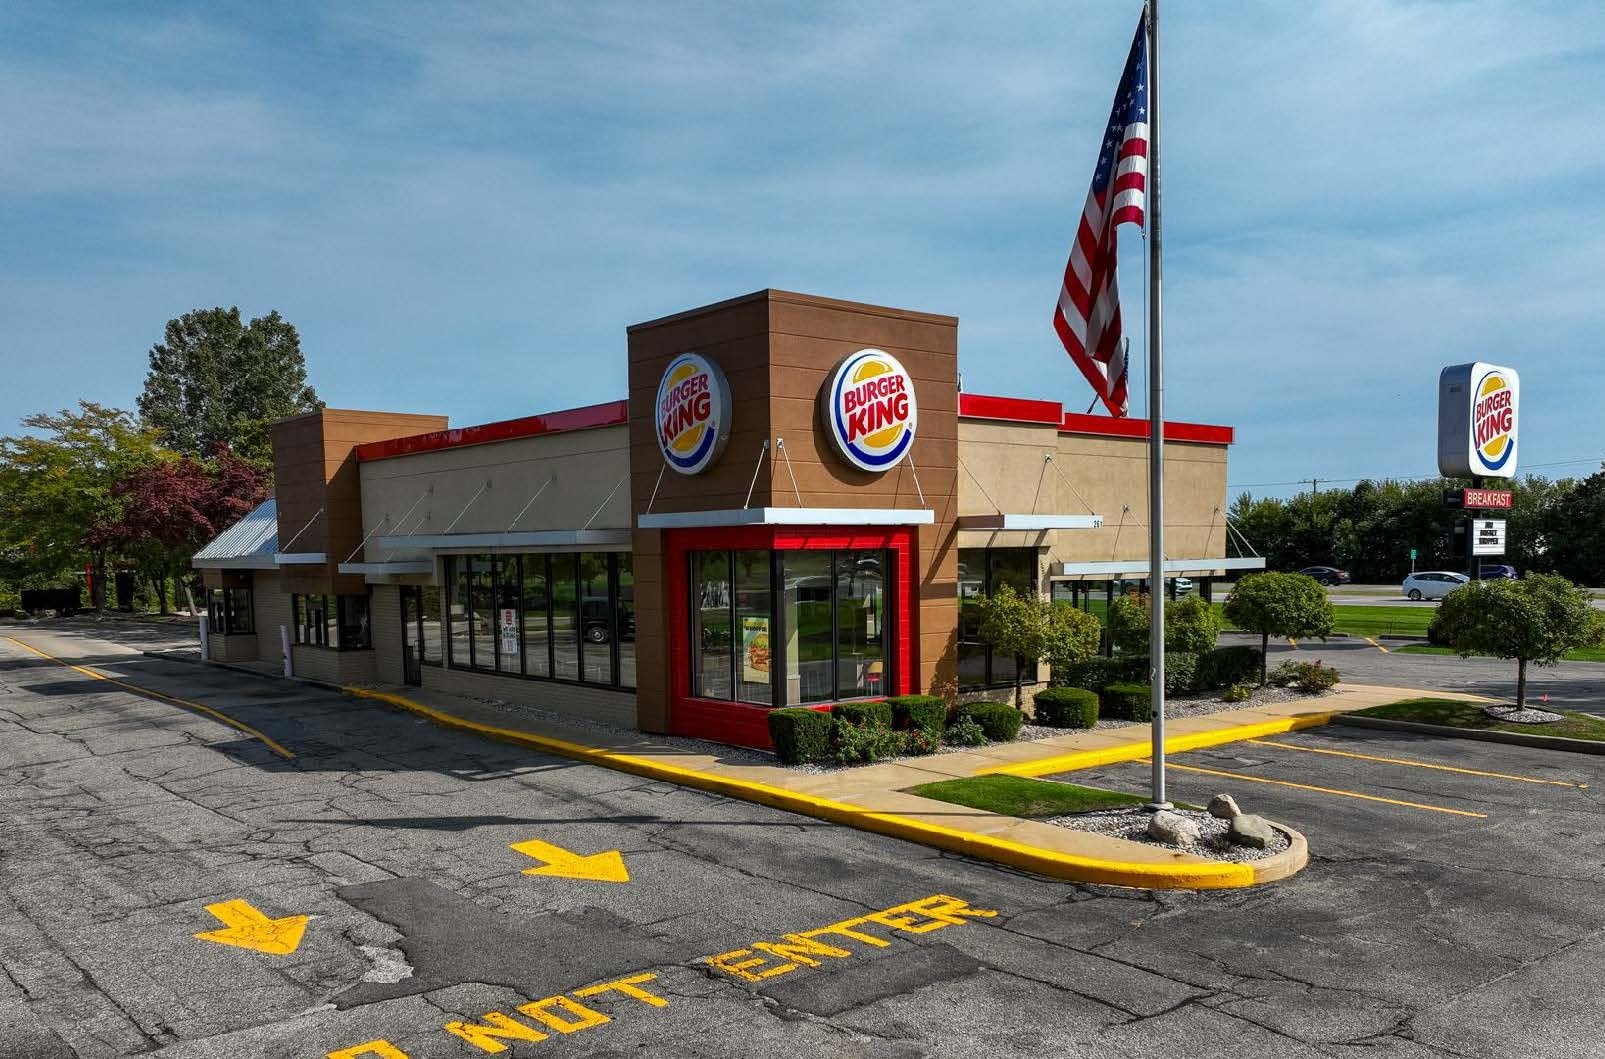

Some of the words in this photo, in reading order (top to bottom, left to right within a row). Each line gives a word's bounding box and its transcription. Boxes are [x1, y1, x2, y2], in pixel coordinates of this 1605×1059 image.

[661, 373, 708, 418] BURGER
[844, 374, 905, 413] BURGER
[1476, 390, 1511, 423] BURGER
[662, 392, 711, 447] KING
[848, 394, 909, 443] KING
[1476, 407, 1512, 449] KING
[1467, 492, 1511, 507] BREAKFAST
[444, 972, 669, 1054] NOT
[705, 894, 998, 982] ENTER
